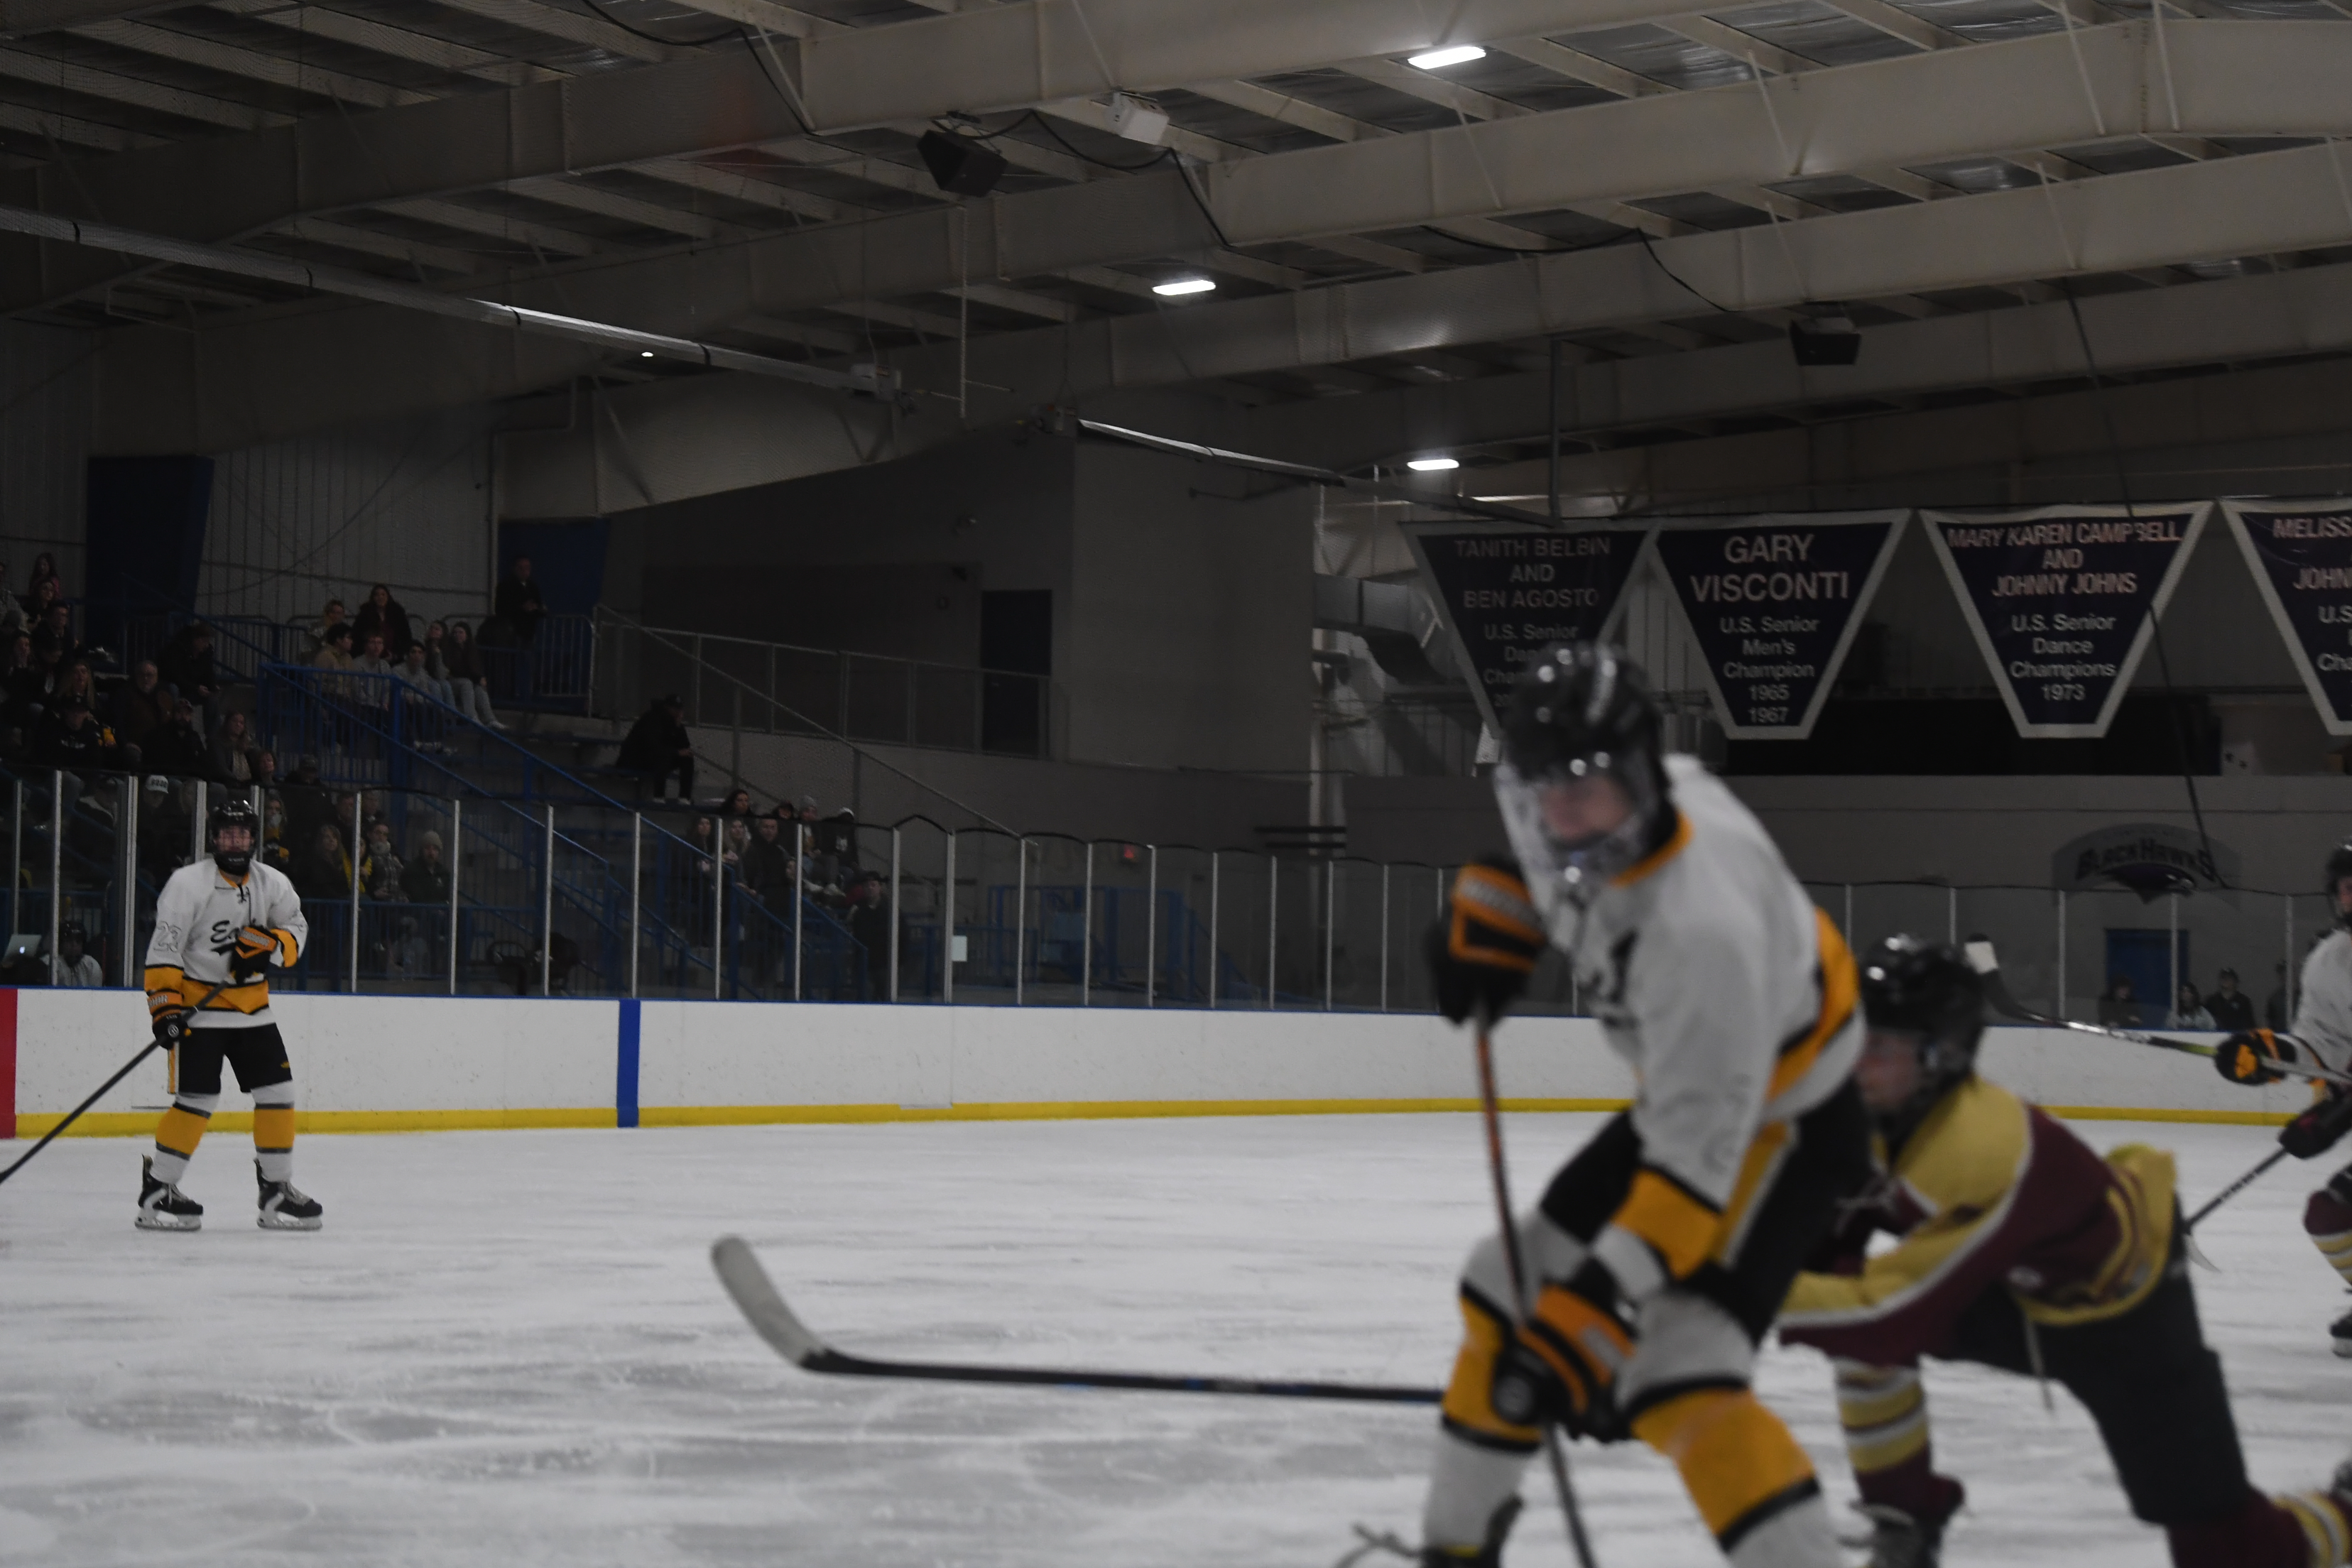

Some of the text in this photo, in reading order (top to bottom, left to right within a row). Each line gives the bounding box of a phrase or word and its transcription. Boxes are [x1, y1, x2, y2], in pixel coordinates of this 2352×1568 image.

[1947, 528, 2005, 548] MARY
[2006, 523, 2072, 546] KAREN
[1454, 536, 1611, 558] TANITH BELBIN
[1723, 534, 1815, 564] GARY
[2042, 548, 2084, 569] AND
[1509, 564, 1555, 583] AND
[1690, 572, 1849, 603] VISCONTI
[1992, 572, 2138, 597] JOHNNY JOHNS
[1463, 587, 1600, 608] BEN AGOSTO
[1484, 623, 1579, 640] U.S. Senior
[1719, 615, 1820, 634] U.S. Senior
[2011, 613, 2117, 632] U.S. Senior
[1742, 638, 1796, 655] Men's
[2032, 637, 2094, 654] Dance
[1723, 661, 1815, 681] Champion
[2009, 660, 2117, 681] Champions
[2041, 683, 2086, 701] 1973
[1747, 706, 1789, 723] 1967
